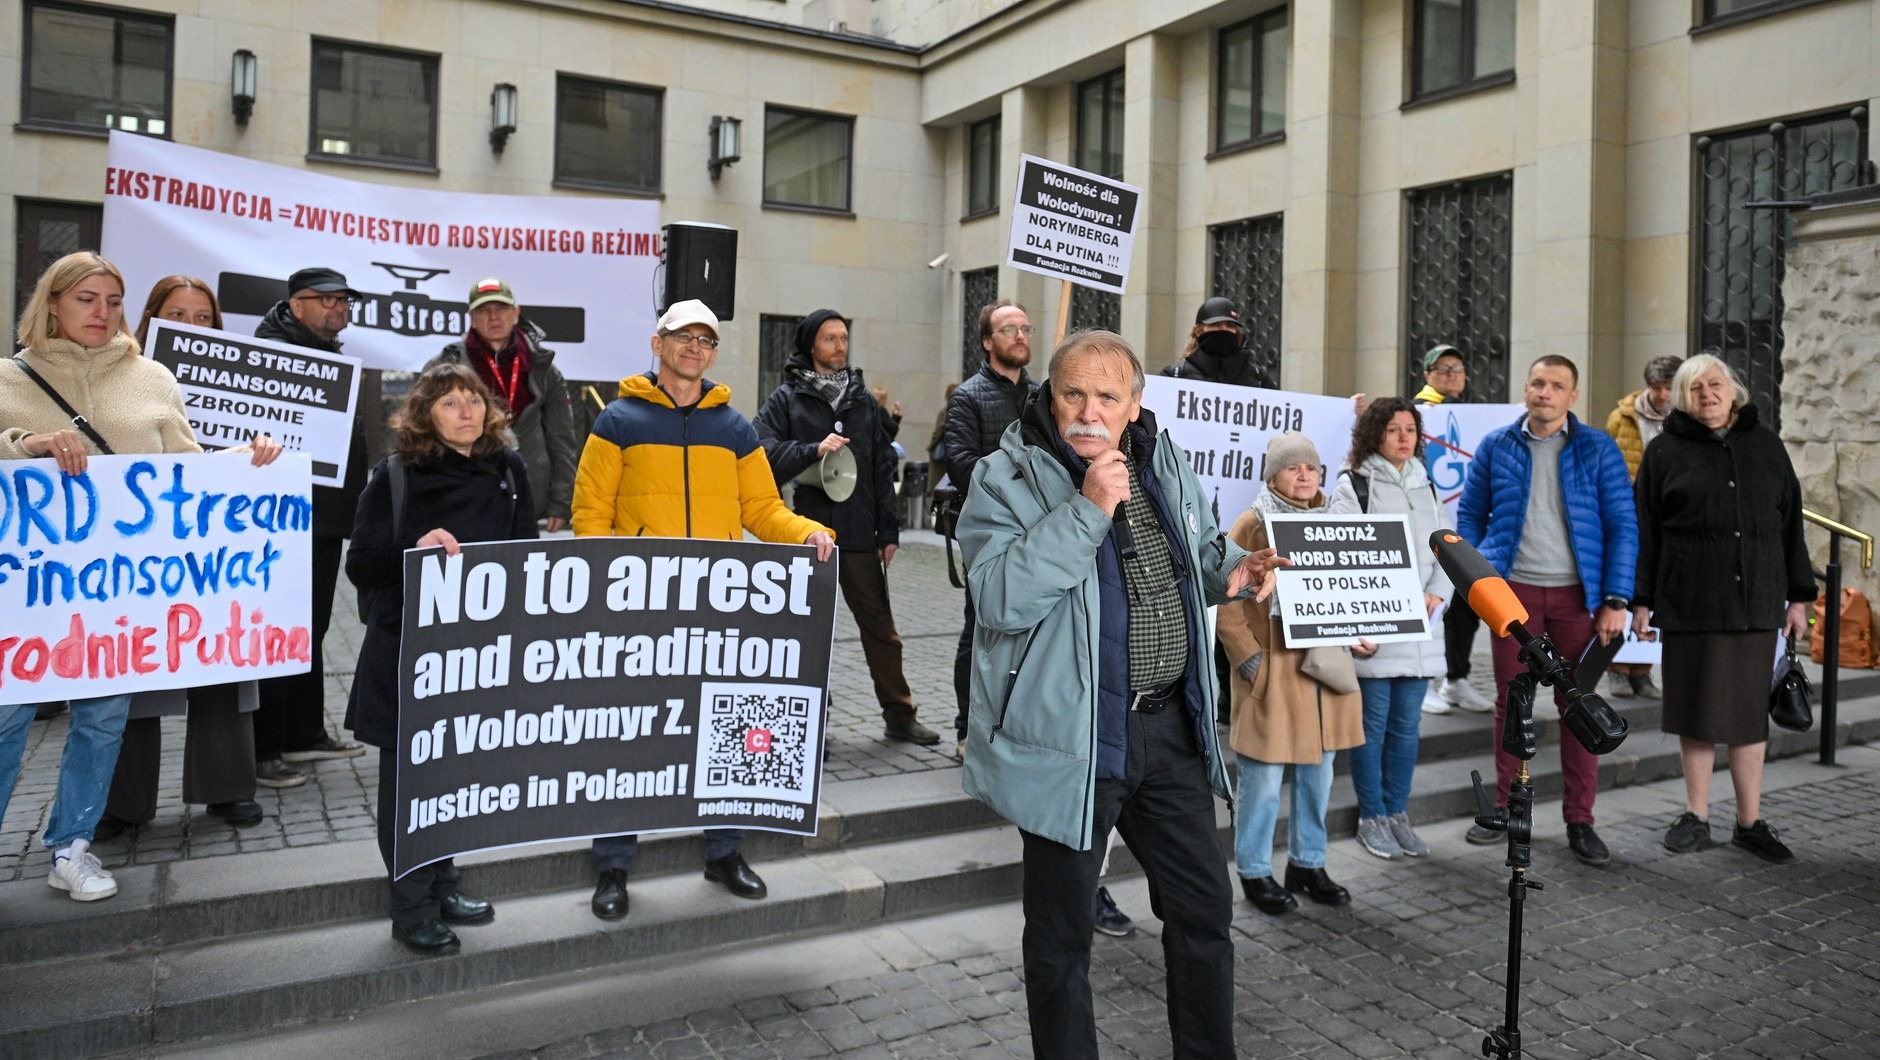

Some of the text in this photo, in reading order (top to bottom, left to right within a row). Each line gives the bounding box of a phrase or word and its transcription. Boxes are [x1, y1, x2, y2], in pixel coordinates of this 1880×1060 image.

[1043, 171, 1120, 205] Wolność dla
[104, 167, 273, 222] EKSTRADYCJA
[447, 225, 585, 254] ROSYJSKIEGO
[592, 228, 662, 257] REŻIMU
[1037, 191, 1114, 226] Wołodymyra
[1028, 212, 1120, 248] NORYMBERGA
[1026, 233, 1120, 269] DLA PUTINA !!!
[1036, 257, 1102, 280] Fundacja Rozkwitu
[172, 336, 339, 382] NORD STREAM
[175, 362, 328, 405] FINANSOWAŁ
[185, 392, 305, 425] ZBRODNIE
[1176, 390, 1303, 433] Ekstradycja
[282, 433, 302, 450] !!!
[1222, 450, 1254, 481] dla
[113, 461, 311, 540] Stream
[1303, 523, 1377, 542] SABOTAŻ
[1289, 550, 1403, 567] NORD STREAM
[418, 552, 814, 628] No to arrest
[1302, 575, 1391, 591] TO POLSKA
[1294, 602, 1347, 617] RACJA
[1351, 600, 1402, 615] STANU
[1317, 623, 1398, 636] Fundacja Rozkwitu
[413, 627, 801, 700] and extradition
[410, 698, 692, 766] of Volodymyr Z.
[527, 775, 559, 808] in
[565, 763, 689, 804] Poland!
[698, 800, 805, 823] podpisz petycję
